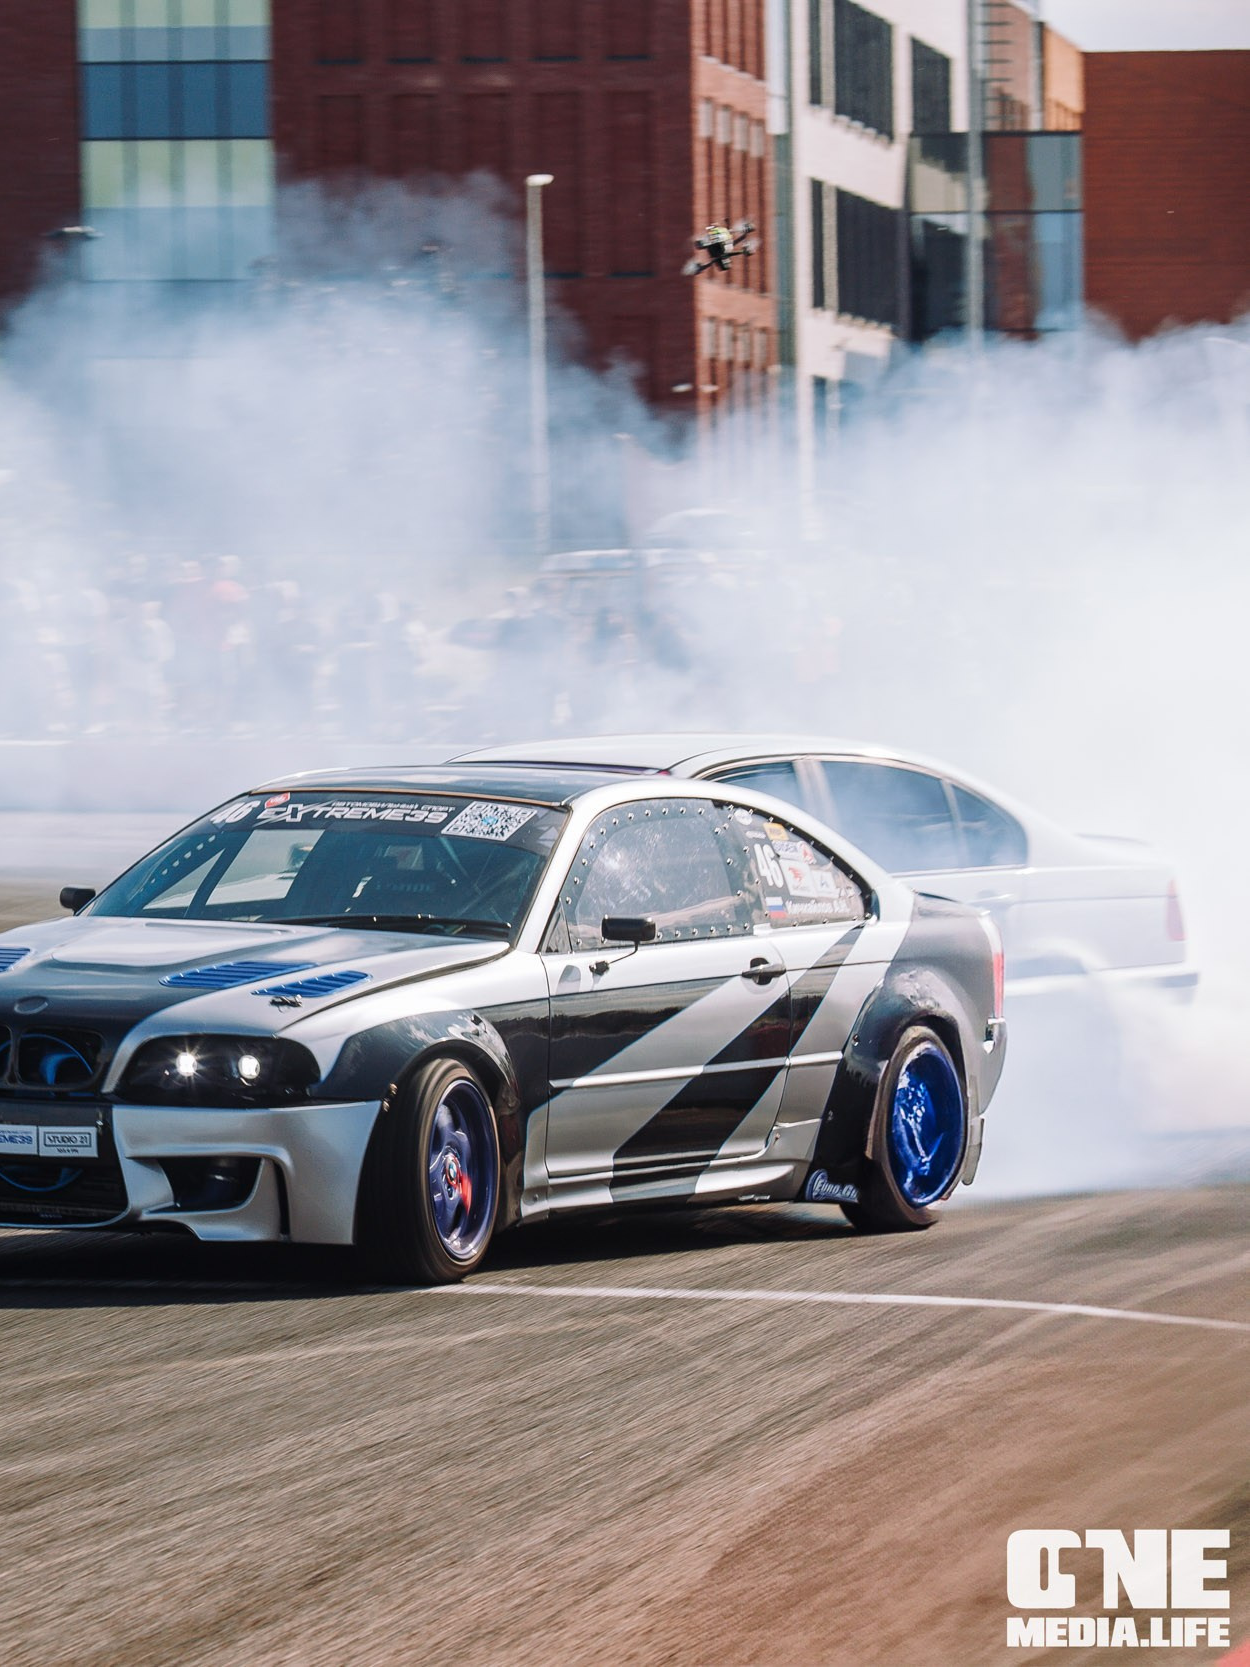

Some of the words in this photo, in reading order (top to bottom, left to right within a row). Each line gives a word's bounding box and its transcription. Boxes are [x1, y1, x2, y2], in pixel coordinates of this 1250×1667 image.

[210, 801, 261, 824] 46
[253, 803, 449, 828] EXTREME39
[753, 843, 784, 888] 46
